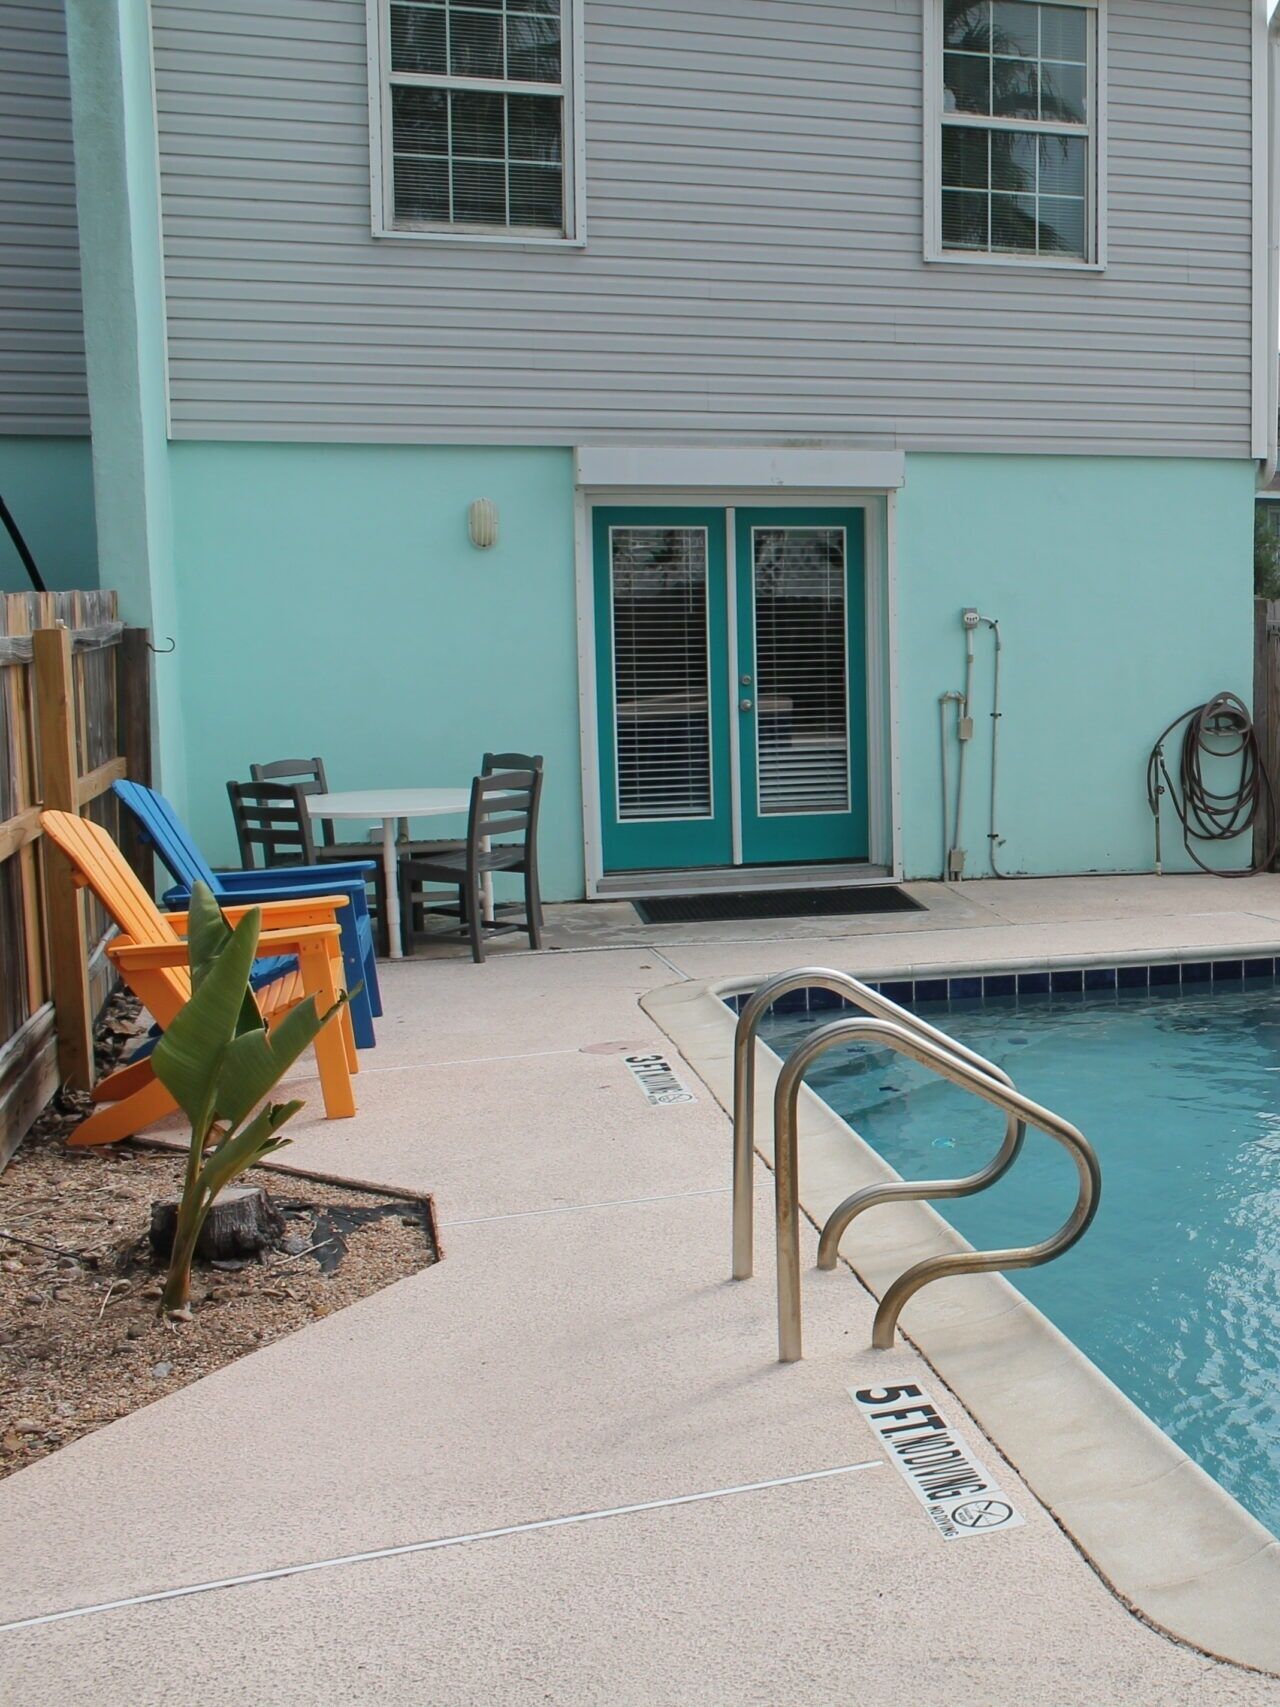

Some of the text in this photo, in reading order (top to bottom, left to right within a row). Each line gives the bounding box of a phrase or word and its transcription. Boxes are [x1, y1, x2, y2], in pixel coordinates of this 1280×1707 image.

[625, 1055, 663, 1063] 3
[856, 1384, 923, 1404] 5
[891, 1432, 955, 1454] NO
[902, 1449, 988, 1501] DIVING
[927, 1505, 960, 1537] NO DIVING
